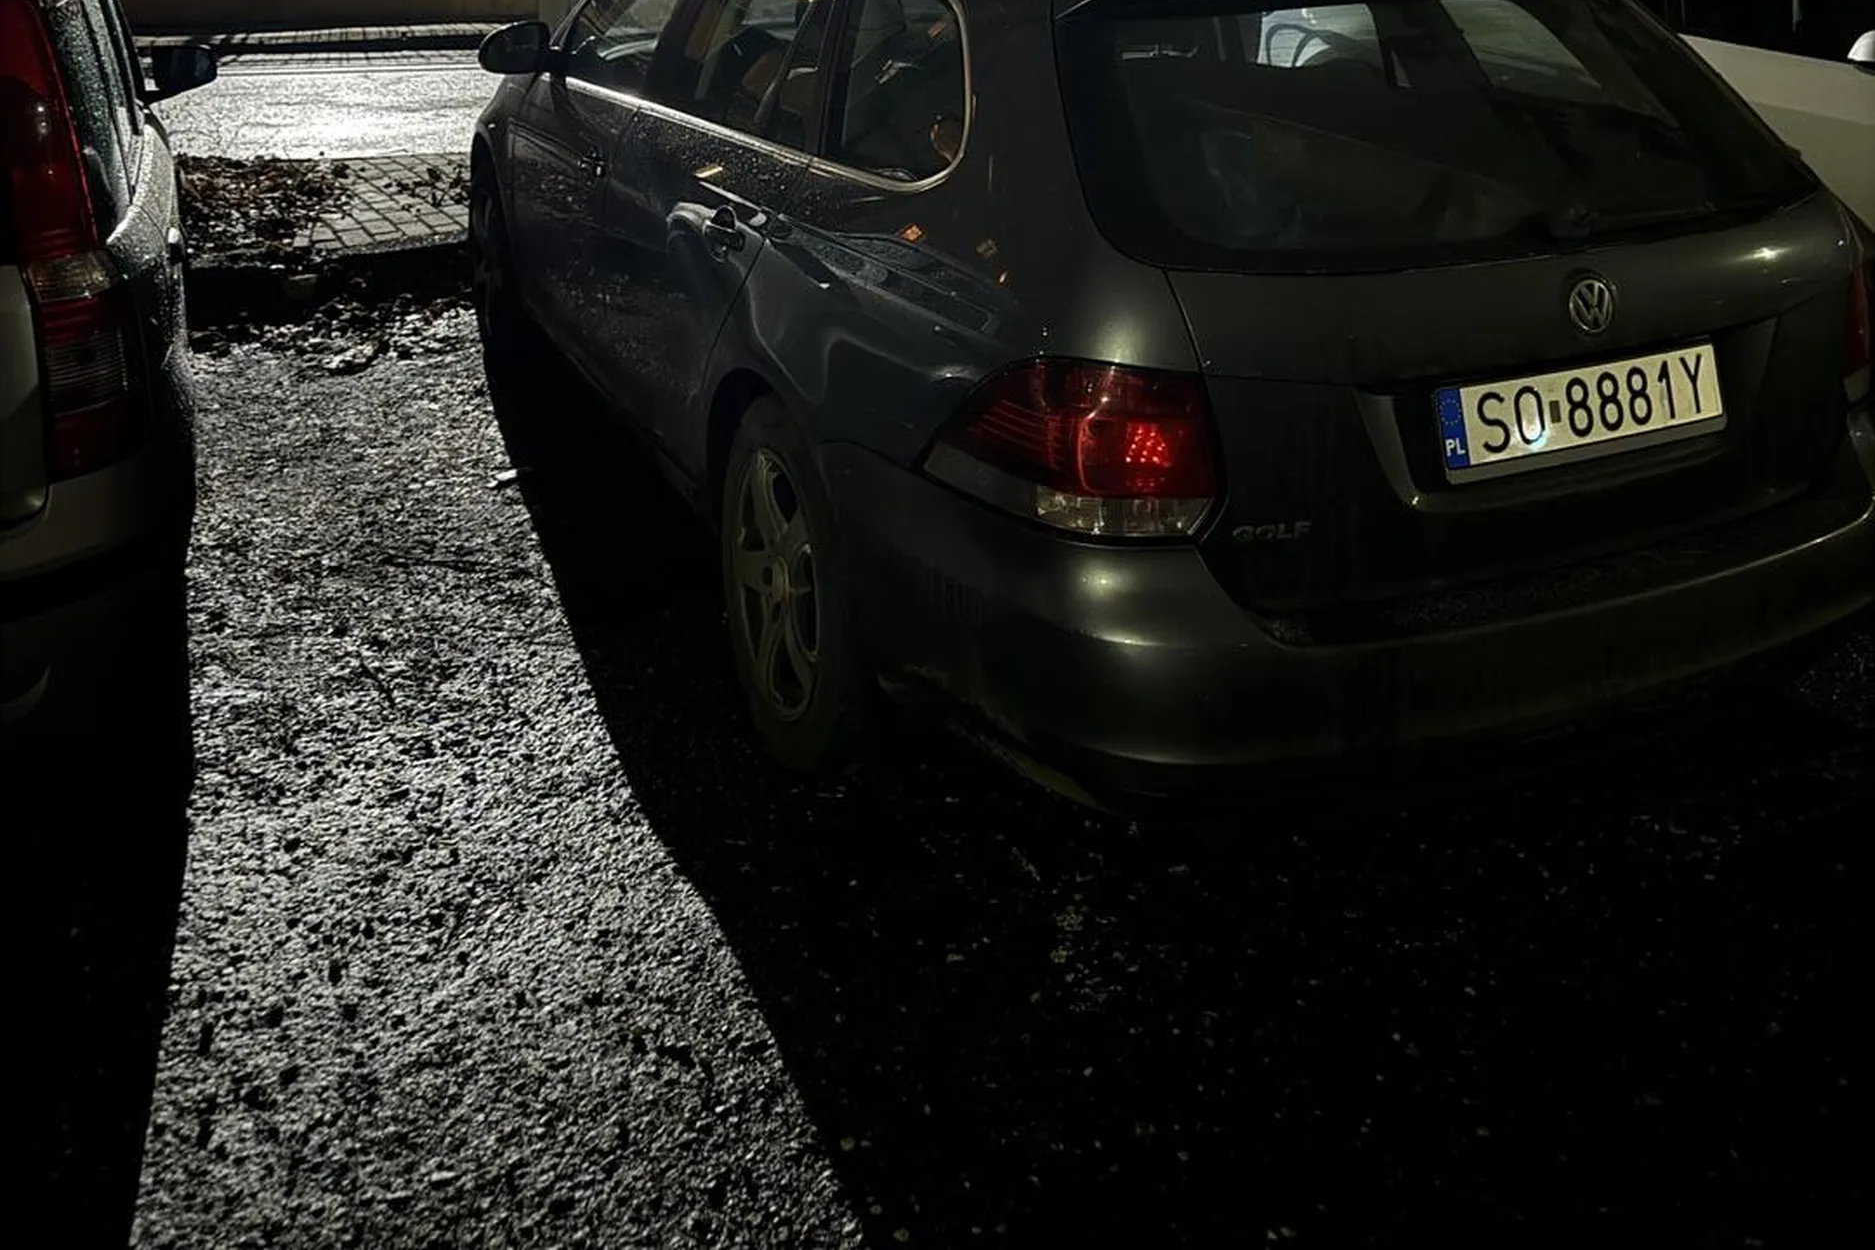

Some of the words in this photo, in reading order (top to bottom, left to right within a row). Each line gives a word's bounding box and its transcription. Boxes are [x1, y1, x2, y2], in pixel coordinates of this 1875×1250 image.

[1477, 385, 1546, 453] SO
[1565, 354, 1702, 437] 8881Y
[1445, 437, 1467, 457] PL
[1231, 520, 1313, 544] GOLF
